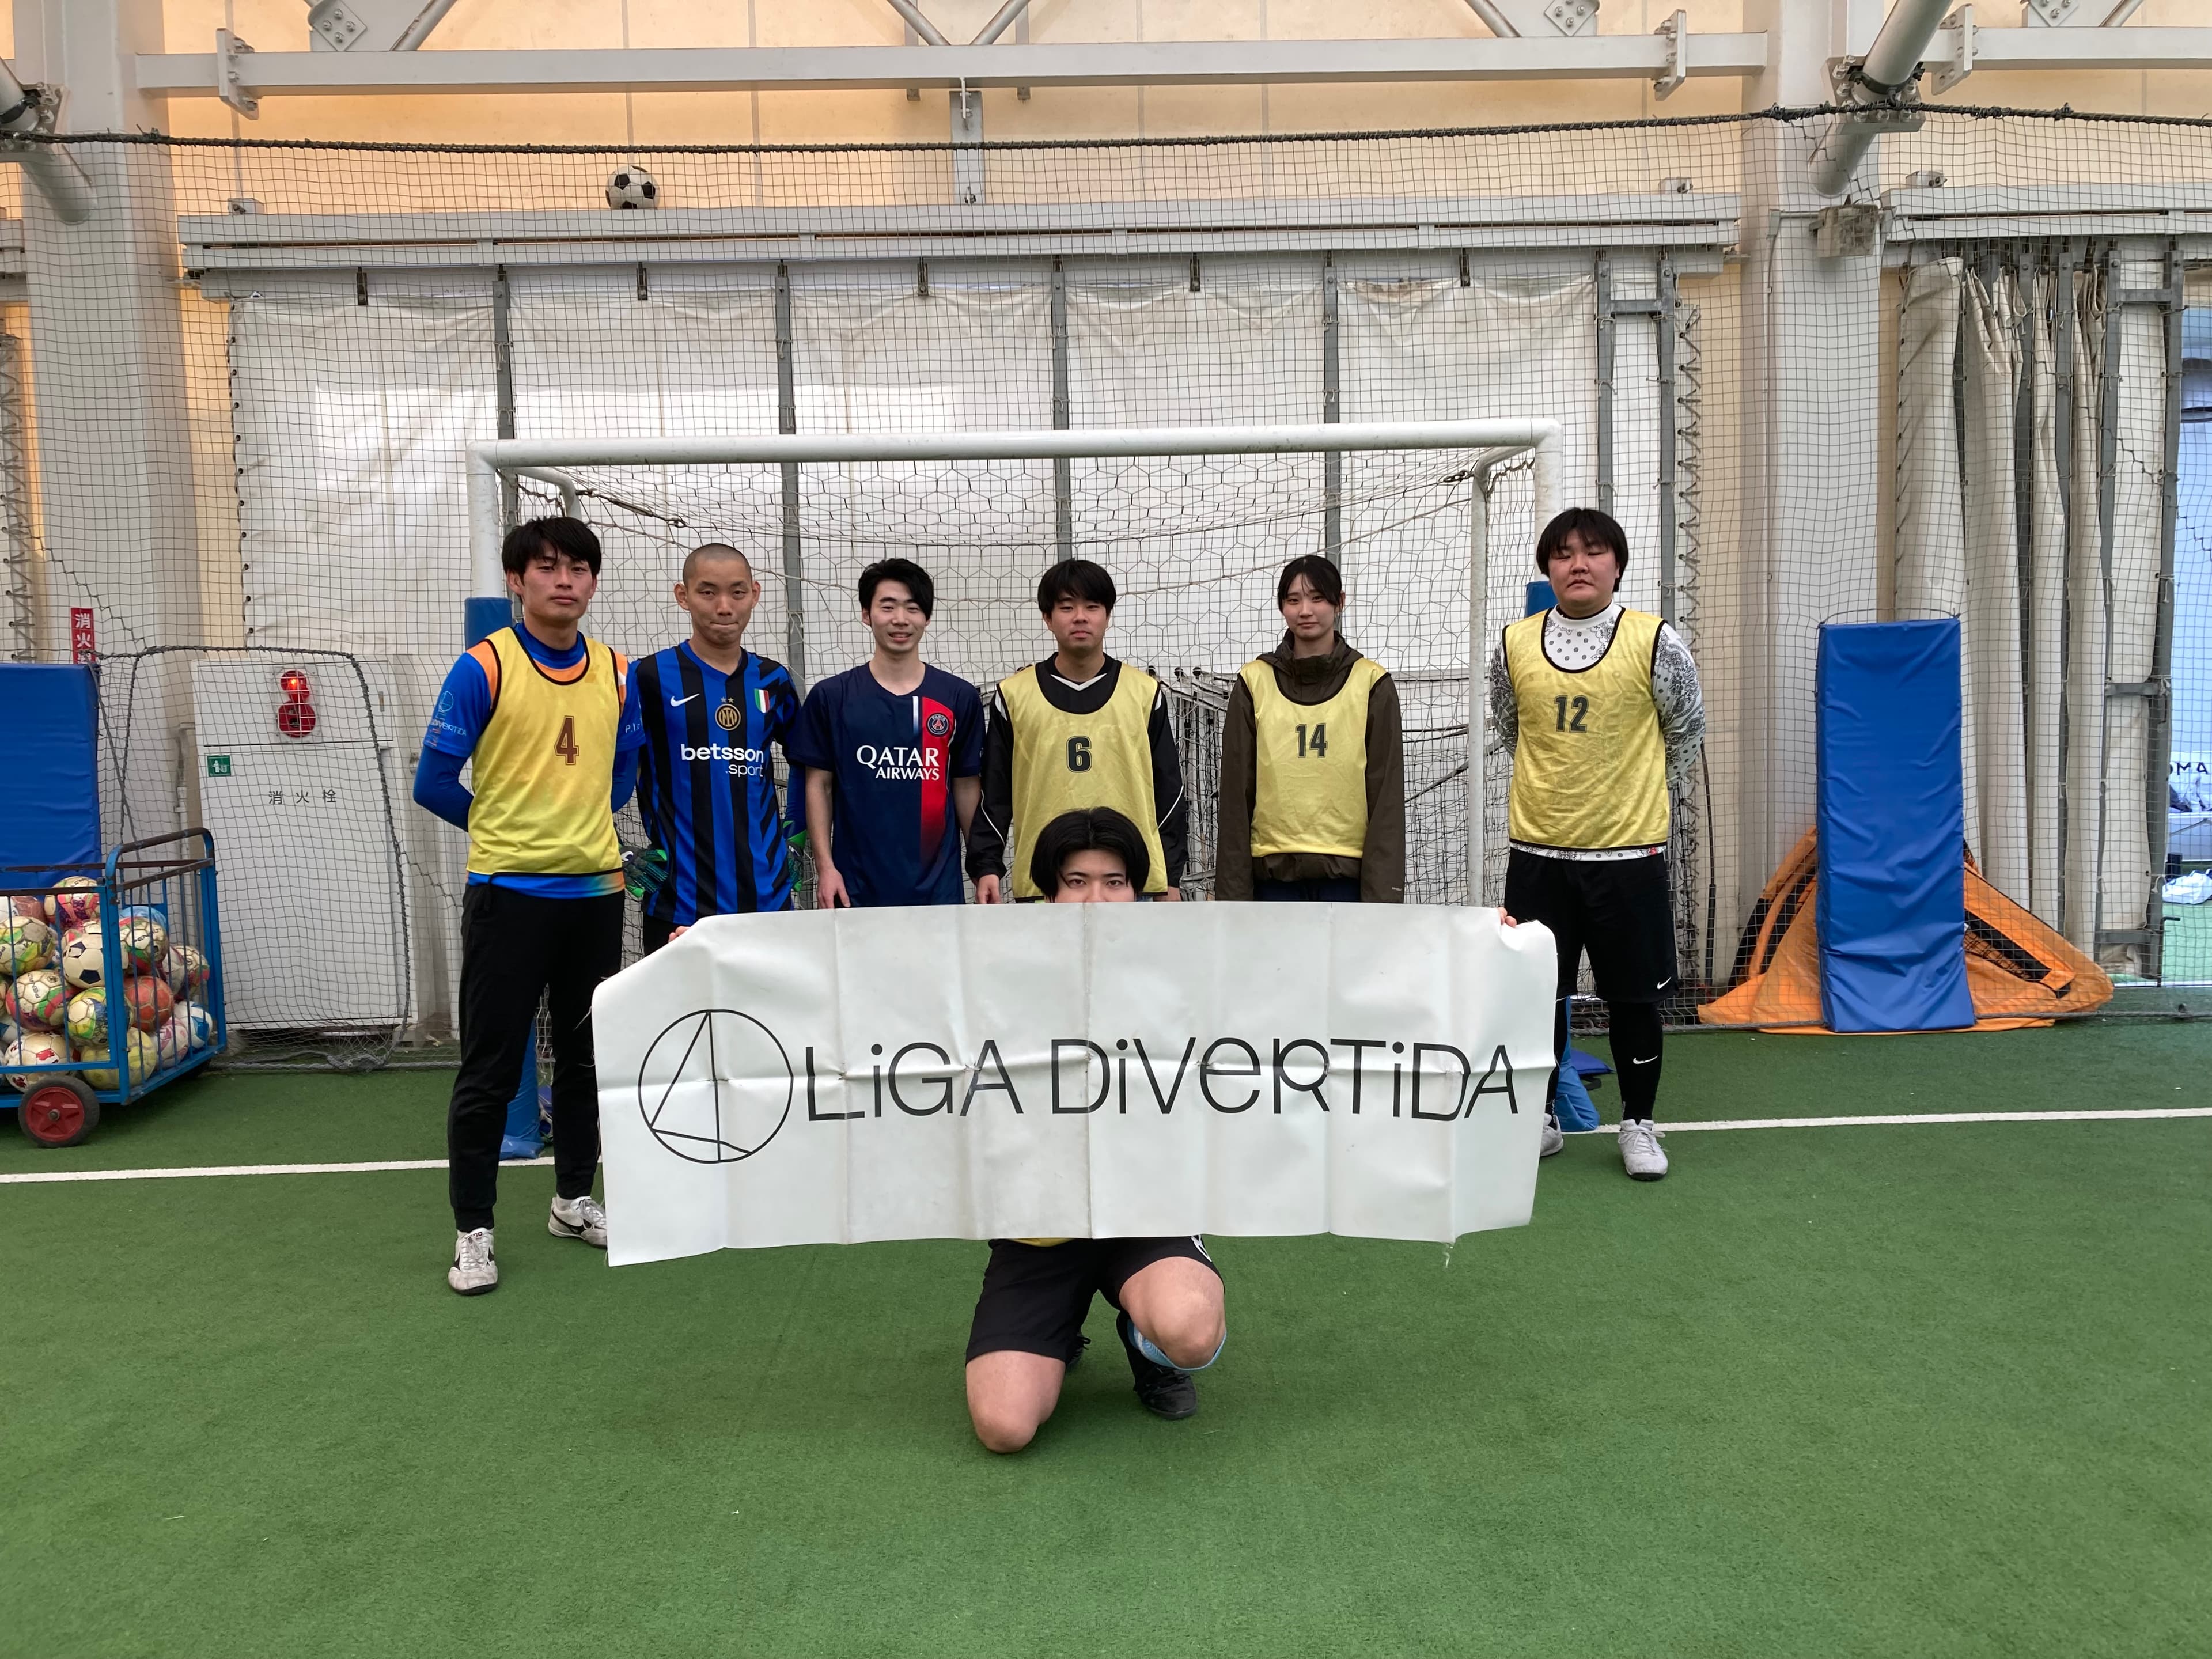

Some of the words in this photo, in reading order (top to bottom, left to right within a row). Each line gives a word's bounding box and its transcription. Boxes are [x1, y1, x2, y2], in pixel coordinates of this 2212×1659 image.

[1554, 695, 1589, 733] 12
[554, 715, 579, 765] 4
[1295, 723, 1328, 758] 14
[680, 743, 764, 763] betsson
[856, 745, 940, 770] QATAR
[1066, 735, 1092, 772] 6
[725, 764, 763, 778] .sport
[875, 767, 940, 781] AIRWAYS
[268, 789, 336, 805] 消火栓
